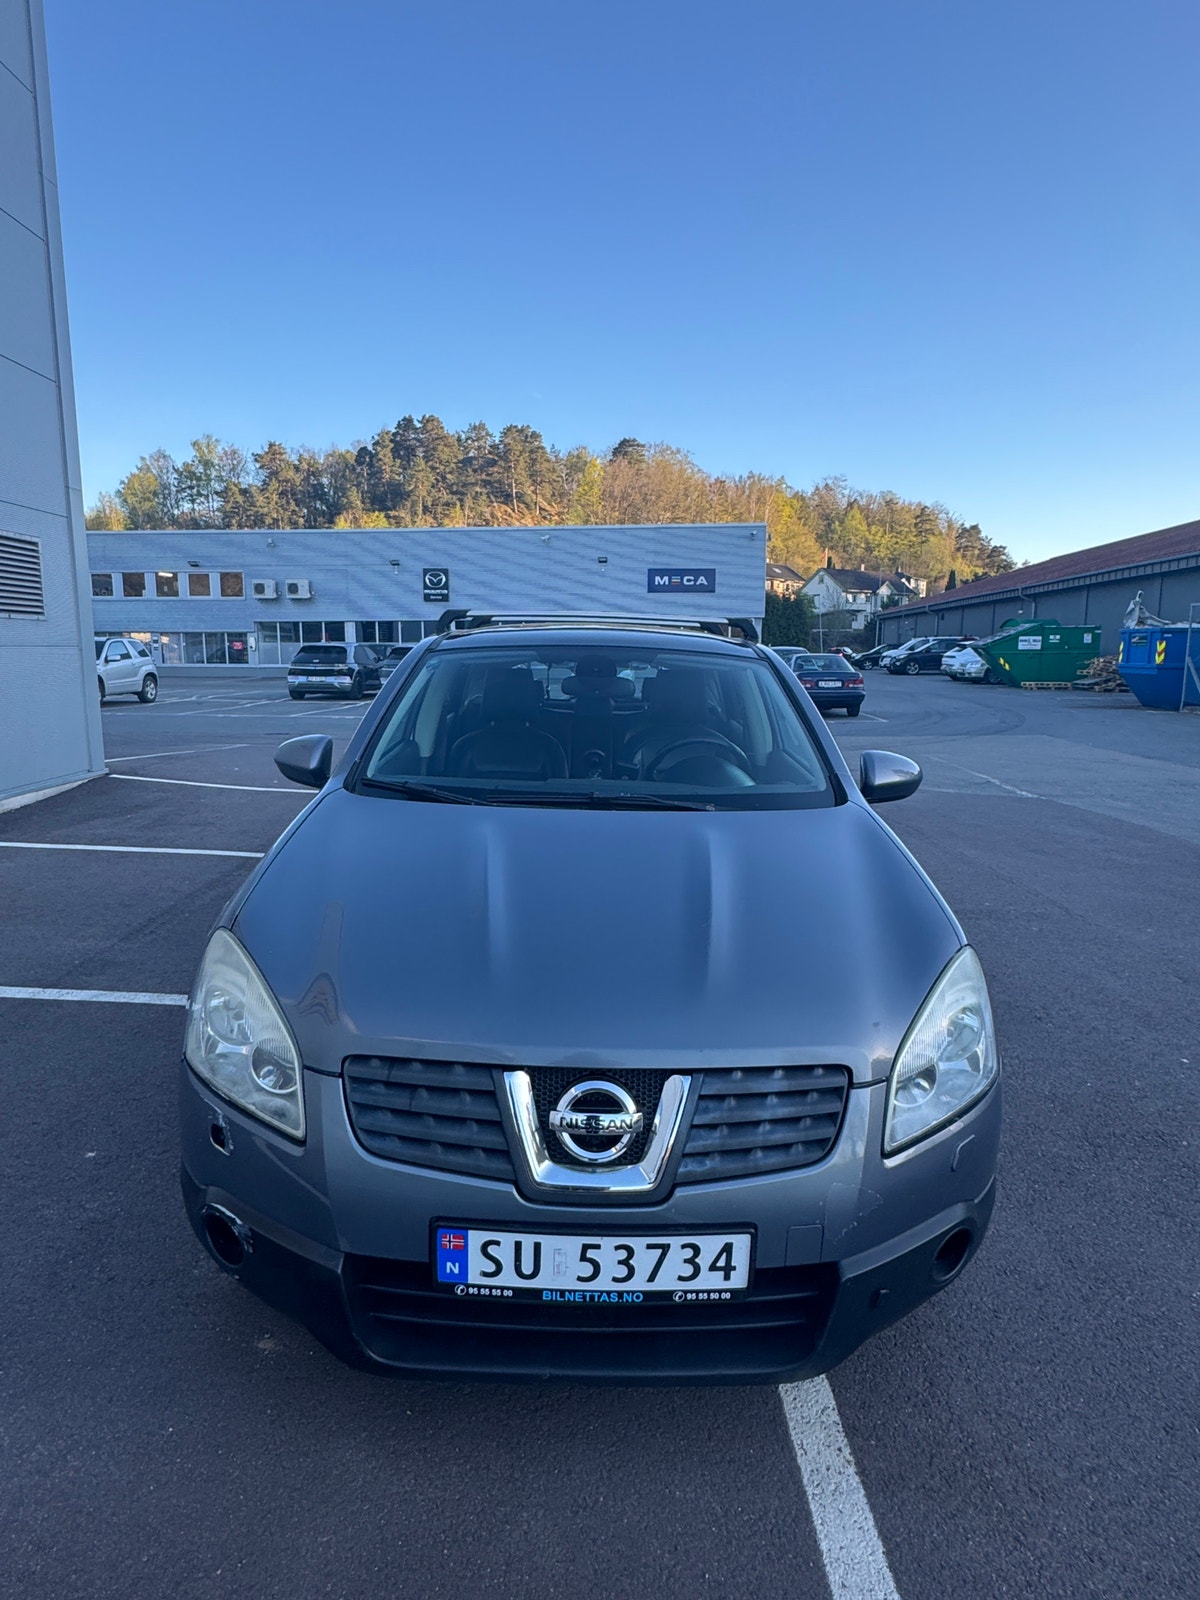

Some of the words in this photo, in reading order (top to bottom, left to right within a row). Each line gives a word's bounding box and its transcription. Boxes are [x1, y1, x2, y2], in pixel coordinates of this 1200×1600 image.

[654, 575, 708, 586] MECA
[559, 1116, 633, 1132] NISSAN
[479, 1239, 542, 1280] SU
[576, 1241, 737, 1283] 53734
[446, 1261, 460, 1275] N
[468, 1287, 479, 1295] 95
[503, 1289, 514, 1297] 00
[542, 1290, 644, 1303] BILNETTAS.NO
[686, 1292, 697, 1300] 95
[721, 1291, 731, 1300] 00
